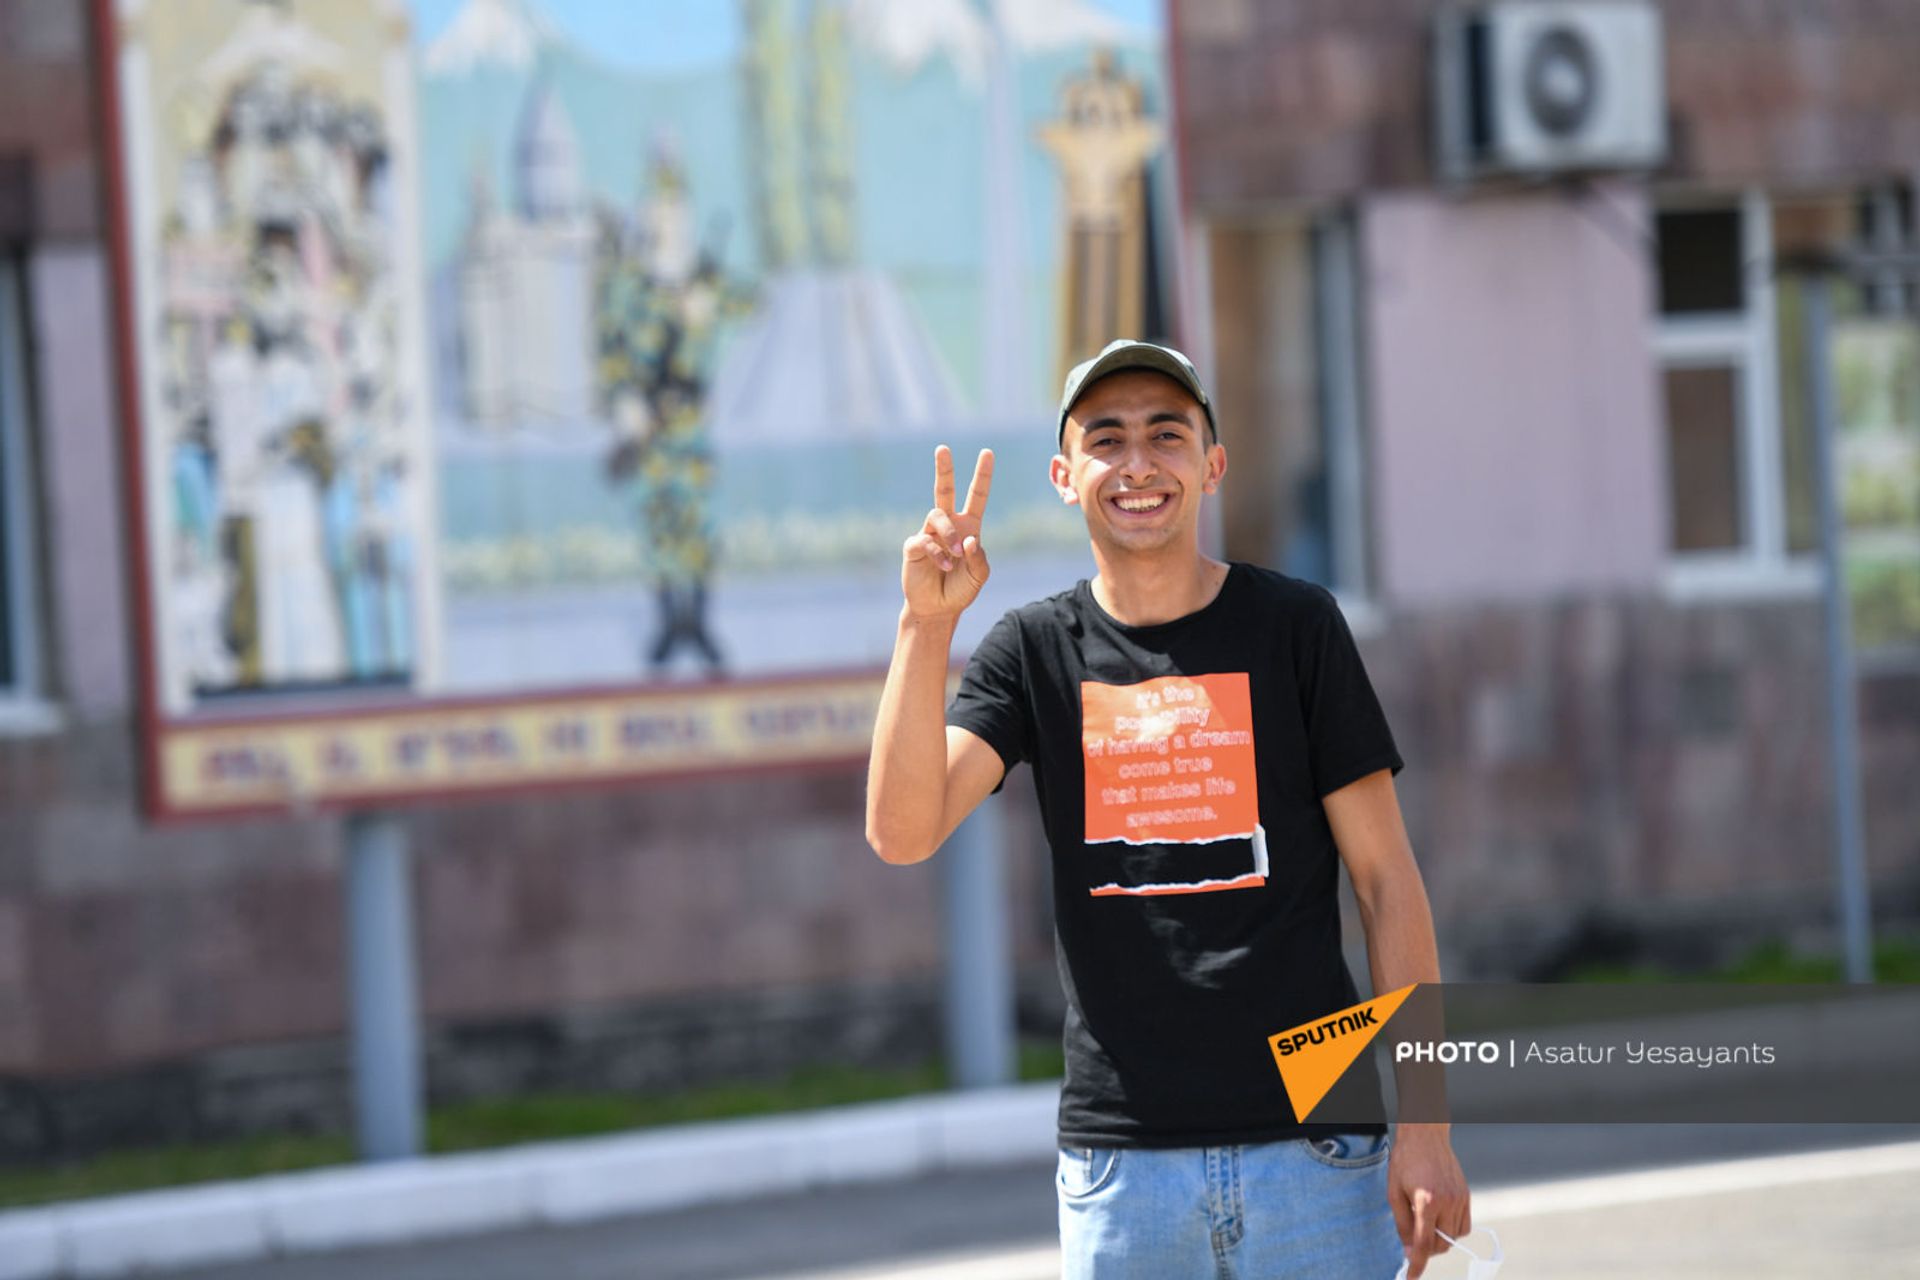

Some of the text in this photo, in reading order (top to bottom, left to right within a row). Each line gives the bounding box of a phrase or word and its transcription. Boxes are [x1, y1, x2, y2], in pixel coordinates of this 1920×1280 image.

[1163, 684, 1195, 702] the
[1087, 729, 1250, 757] of having a dream
[1118, 756, 1213, 780] come true
[1101, 777, 1236, 805] that makes life
[1126, 806, 1217, 827] awesome.
